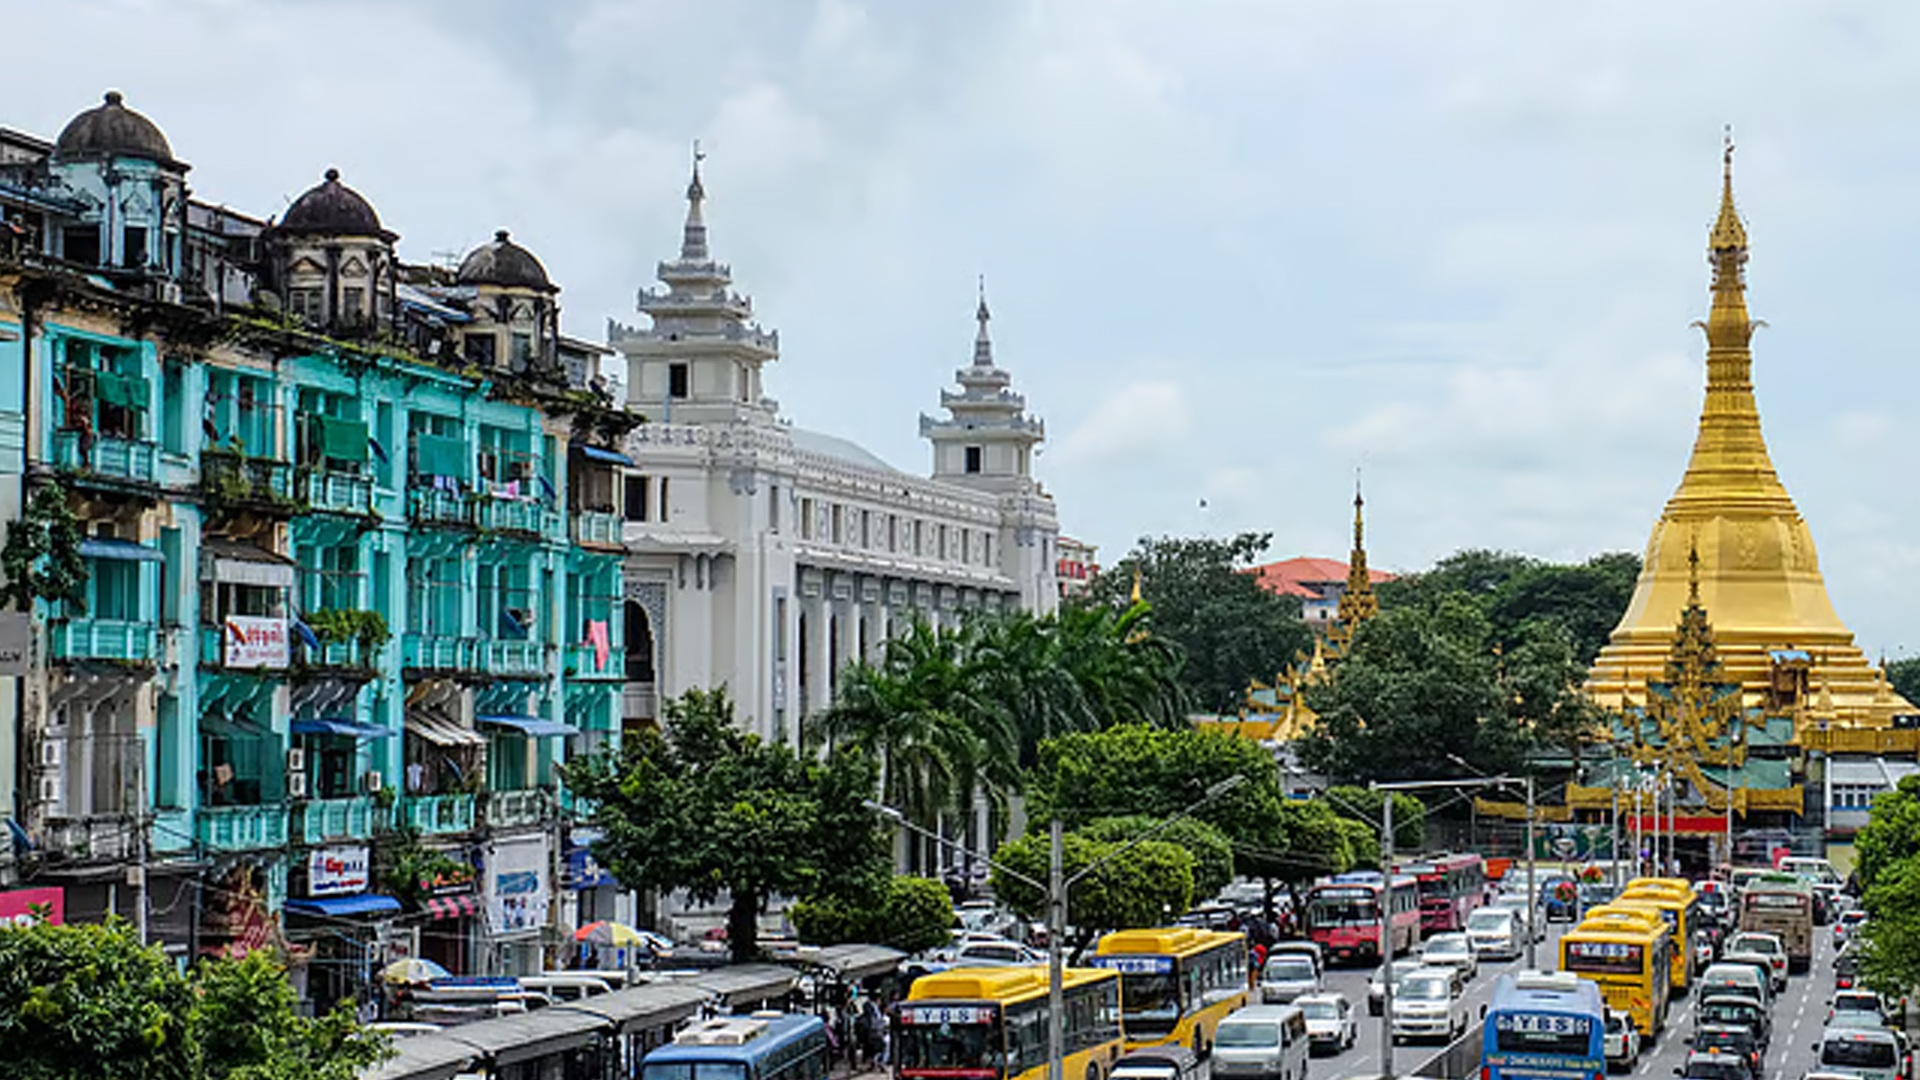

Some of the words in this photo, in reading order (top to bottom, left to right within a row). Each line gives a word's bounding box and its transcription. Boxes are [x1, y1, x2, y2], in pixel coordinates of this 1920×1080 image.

[1584, 944, 1625, 956] YBS
[922, 1009, 971, 1022] YBS
[1519, 1014, 1568, 1031] YBS
